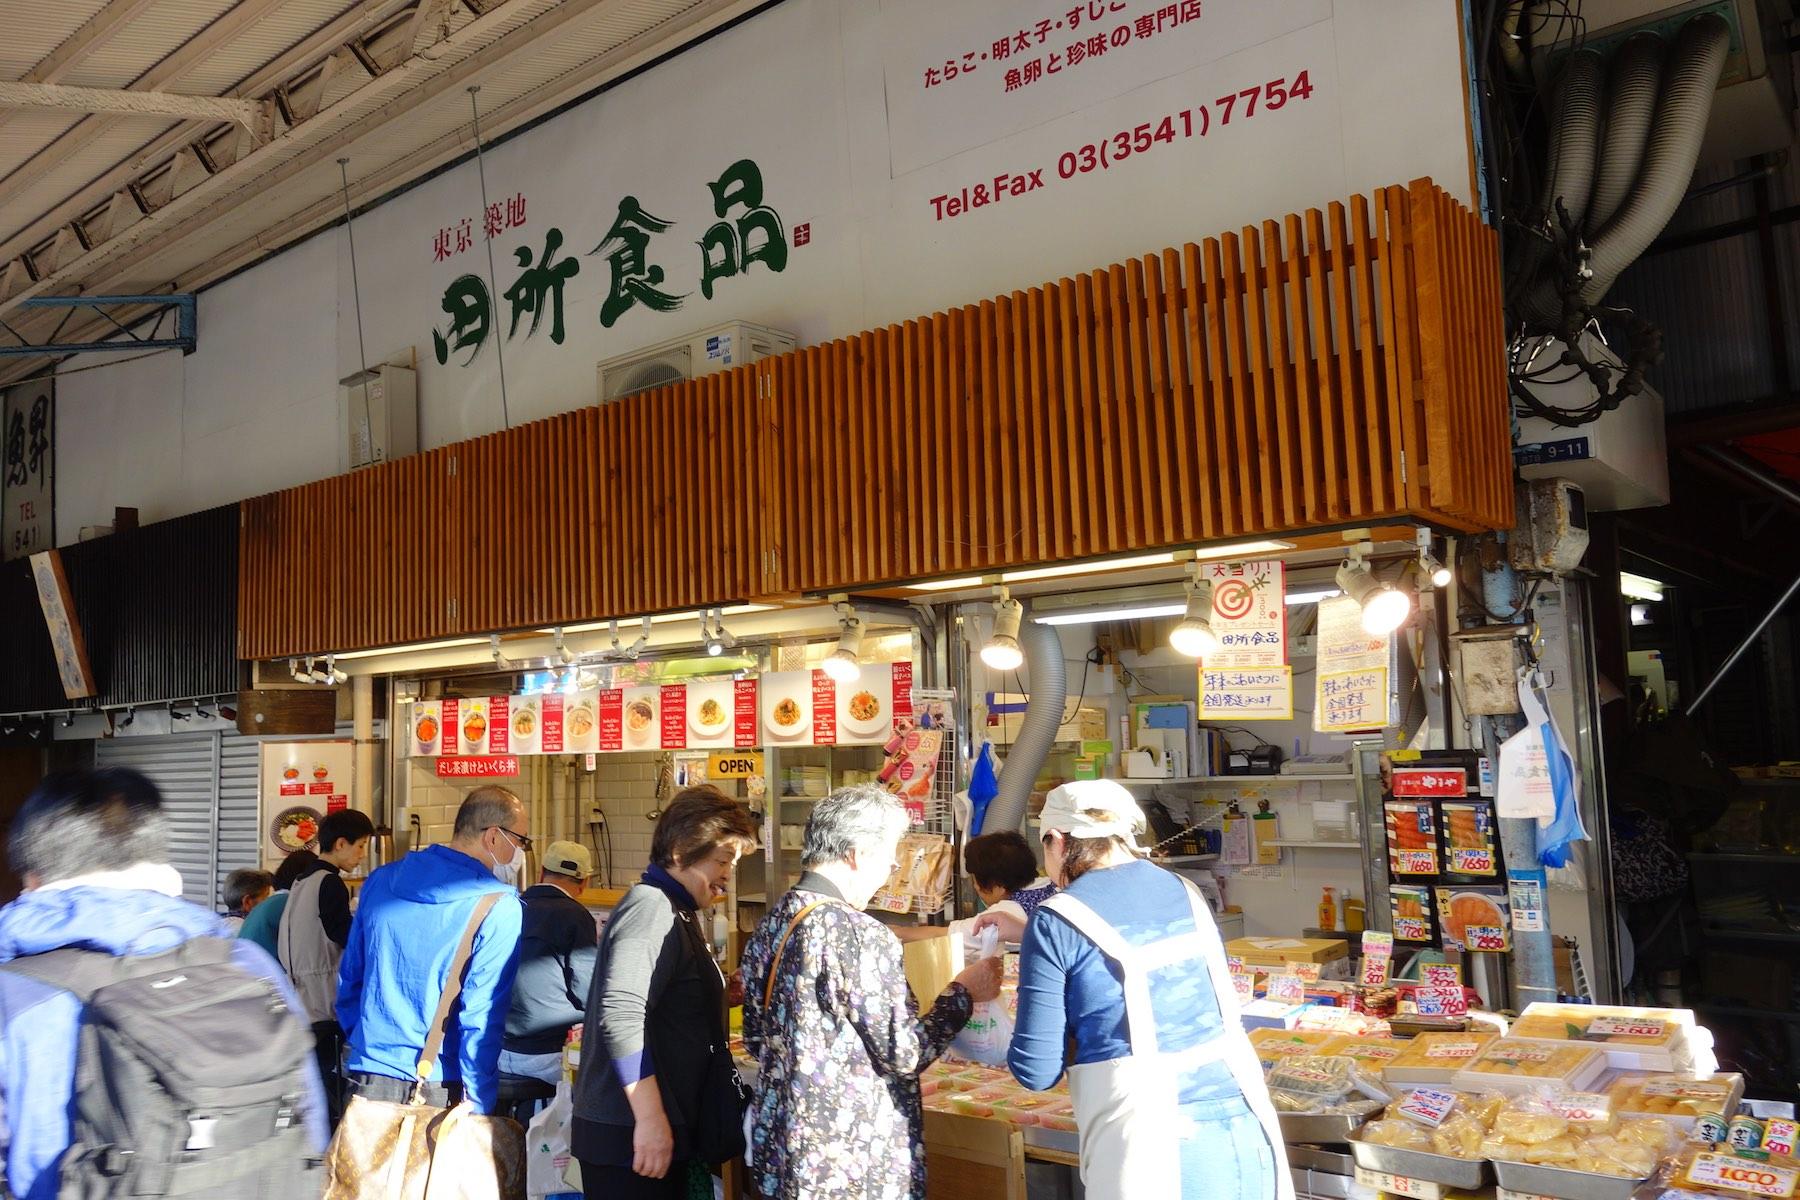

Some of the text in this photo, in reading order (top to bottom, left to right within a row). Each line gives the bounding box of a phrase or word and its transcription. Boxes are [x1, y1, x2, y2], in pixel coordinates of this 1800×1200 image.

[1003, 0, 1202, 92] 魚卵と珍味の専門店
[930, 70, 1314, 221] Tel&Fax 03(3541)7754
[432, 191, 528, 263] 東京 築地
[432, 158, 788, 367] 田所食品
[1548, 442, 1582, 458] 9-11
[19, 500, 36, 523] TEL
[438, 760, 516, 774] だし茶漬けといくら丼
[719, 759, 754, 773] OPEN
